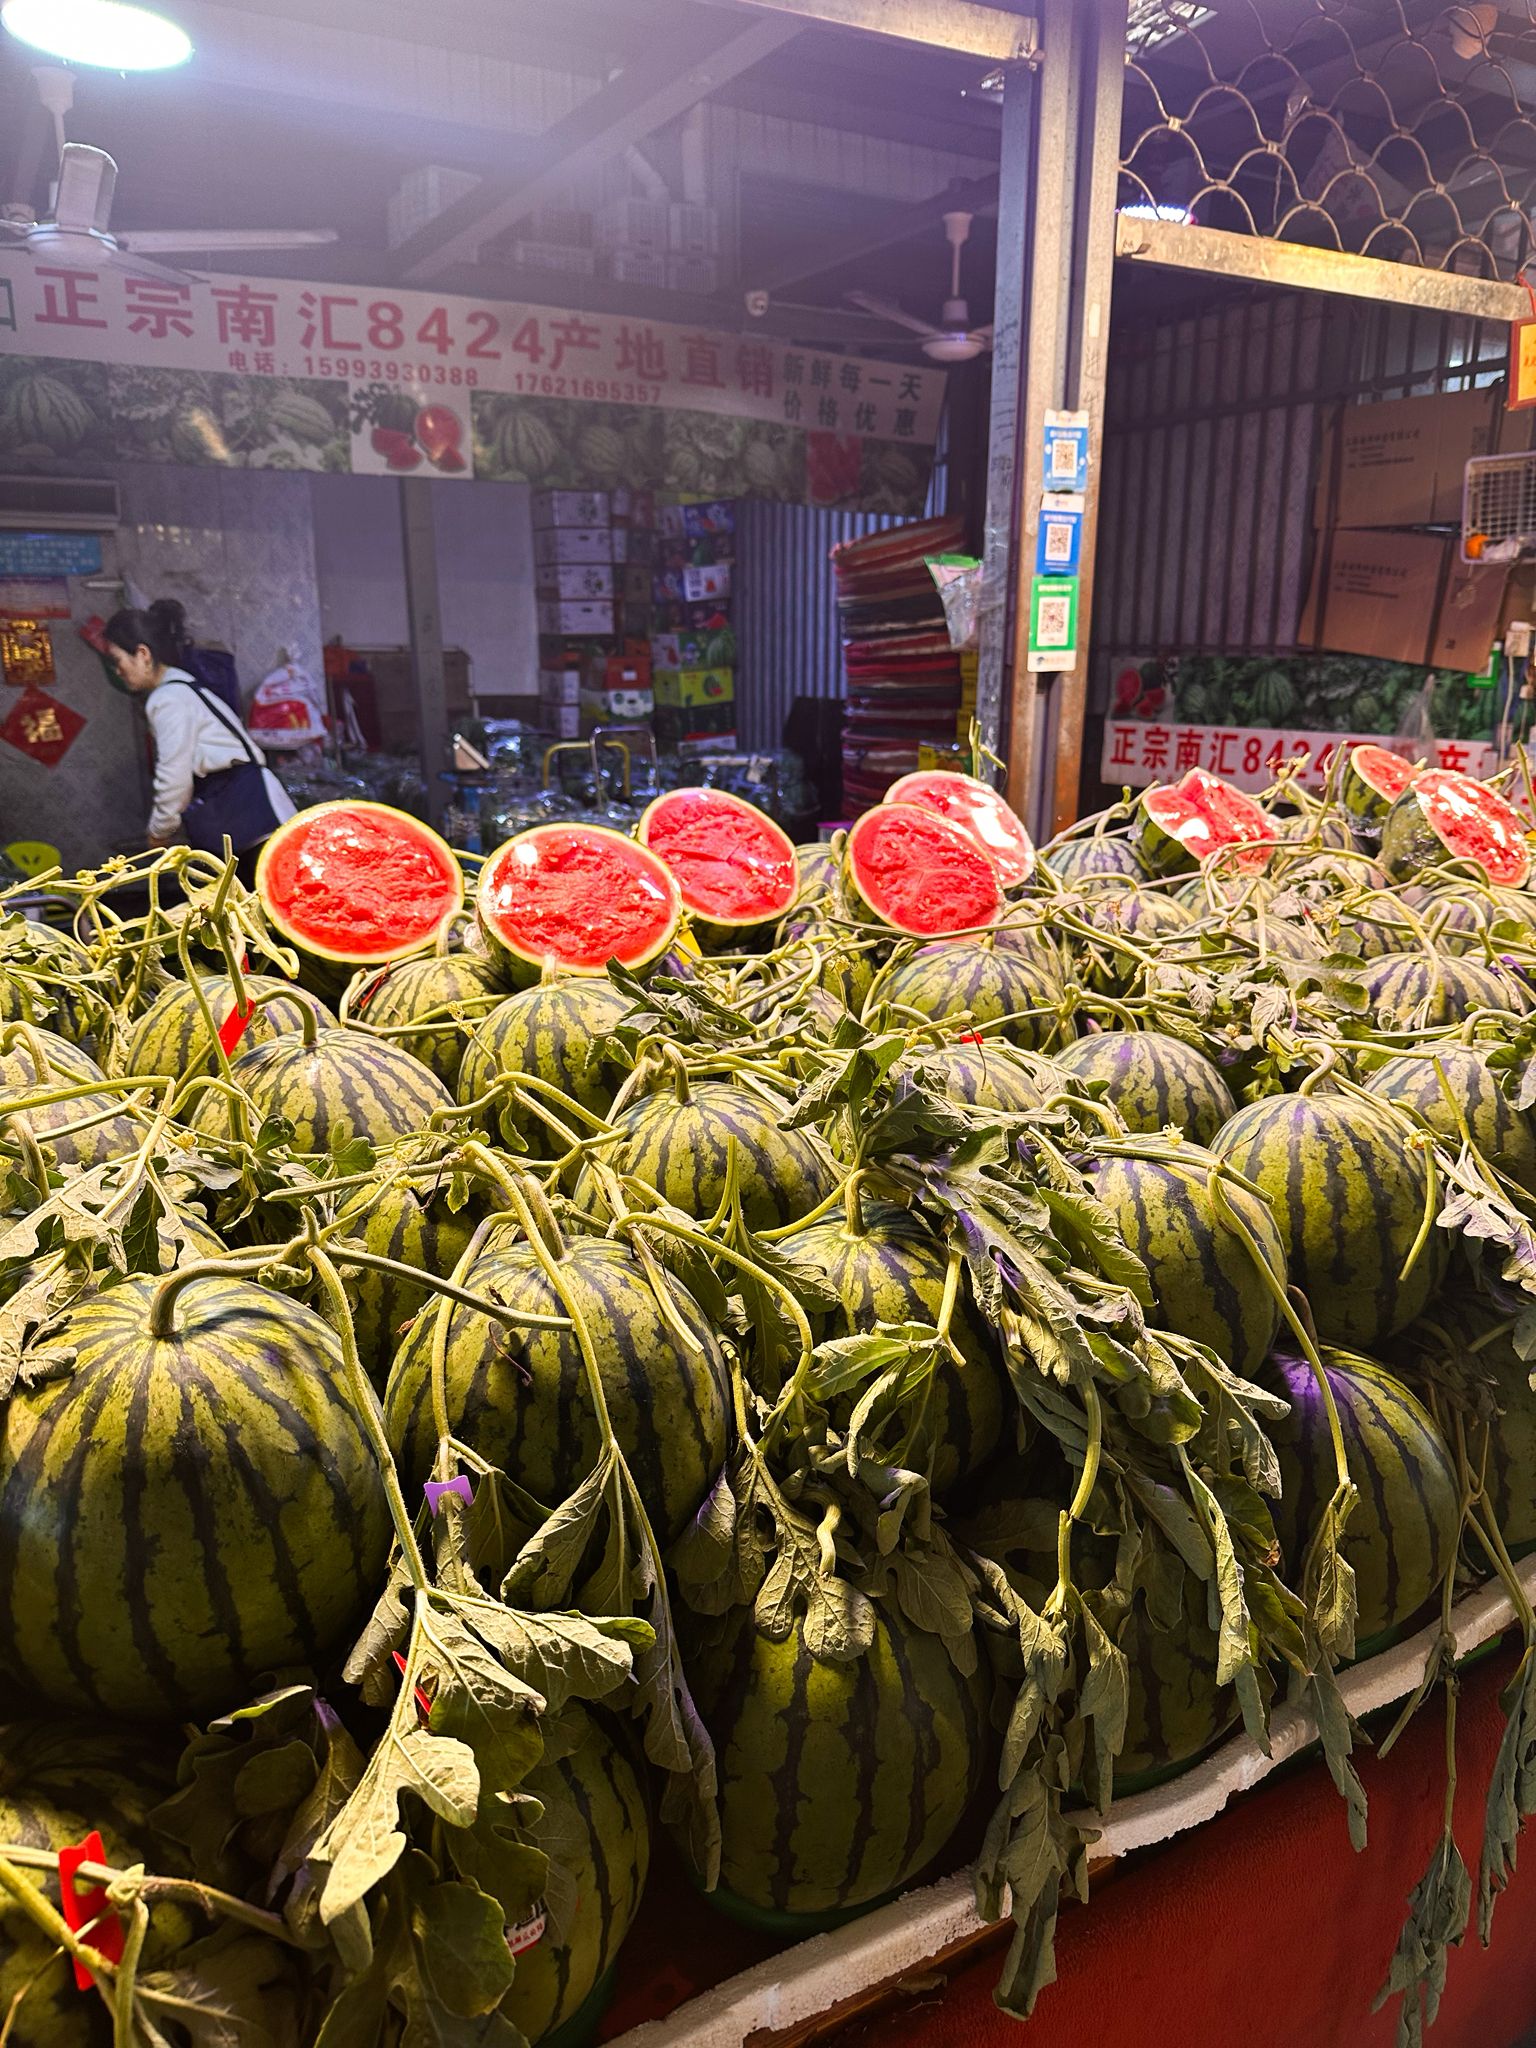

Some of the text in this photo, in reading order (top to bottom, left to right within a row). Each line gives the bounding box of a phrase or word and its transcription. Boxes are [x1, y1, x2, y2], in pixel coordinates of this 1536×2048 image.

[35, 266, 773, 398] 正宗南汇8424产地直销
[514, 372, 662, 403] 17621695357
[783, 352, 922, 401] 新鲜每一天
[784, 387, 917, 436] 价格优惠
[21, 707, 63, 744] 福
